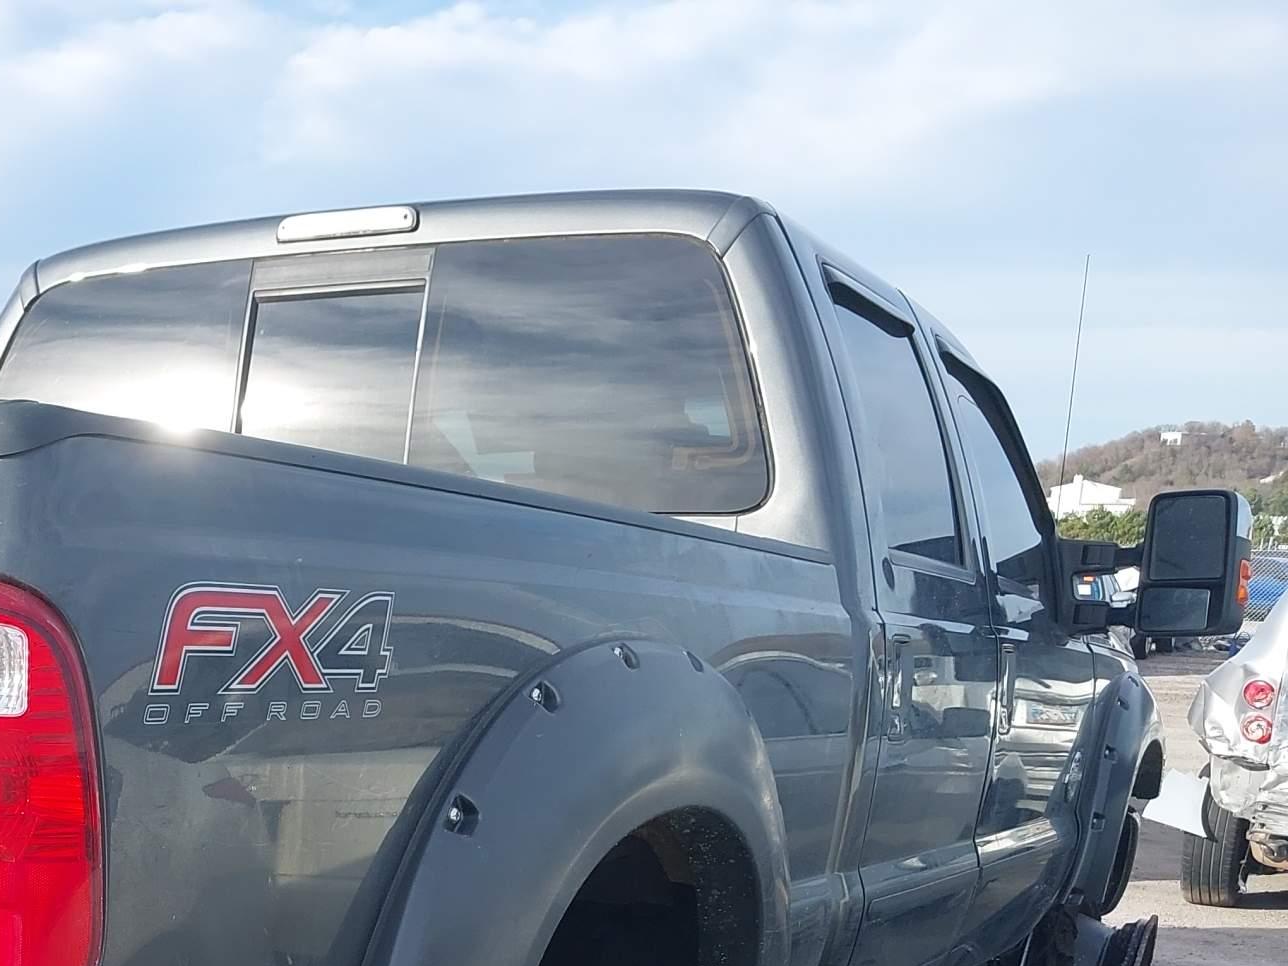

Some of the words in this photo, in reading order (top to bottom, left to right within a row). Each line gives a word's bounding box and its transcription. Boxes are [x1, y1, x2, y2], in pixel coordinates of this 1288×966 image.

[148, 581, 396, 696] FX4
[143, 702, 245, 725] OFF
[266, 699, 383, 721] ROAD
